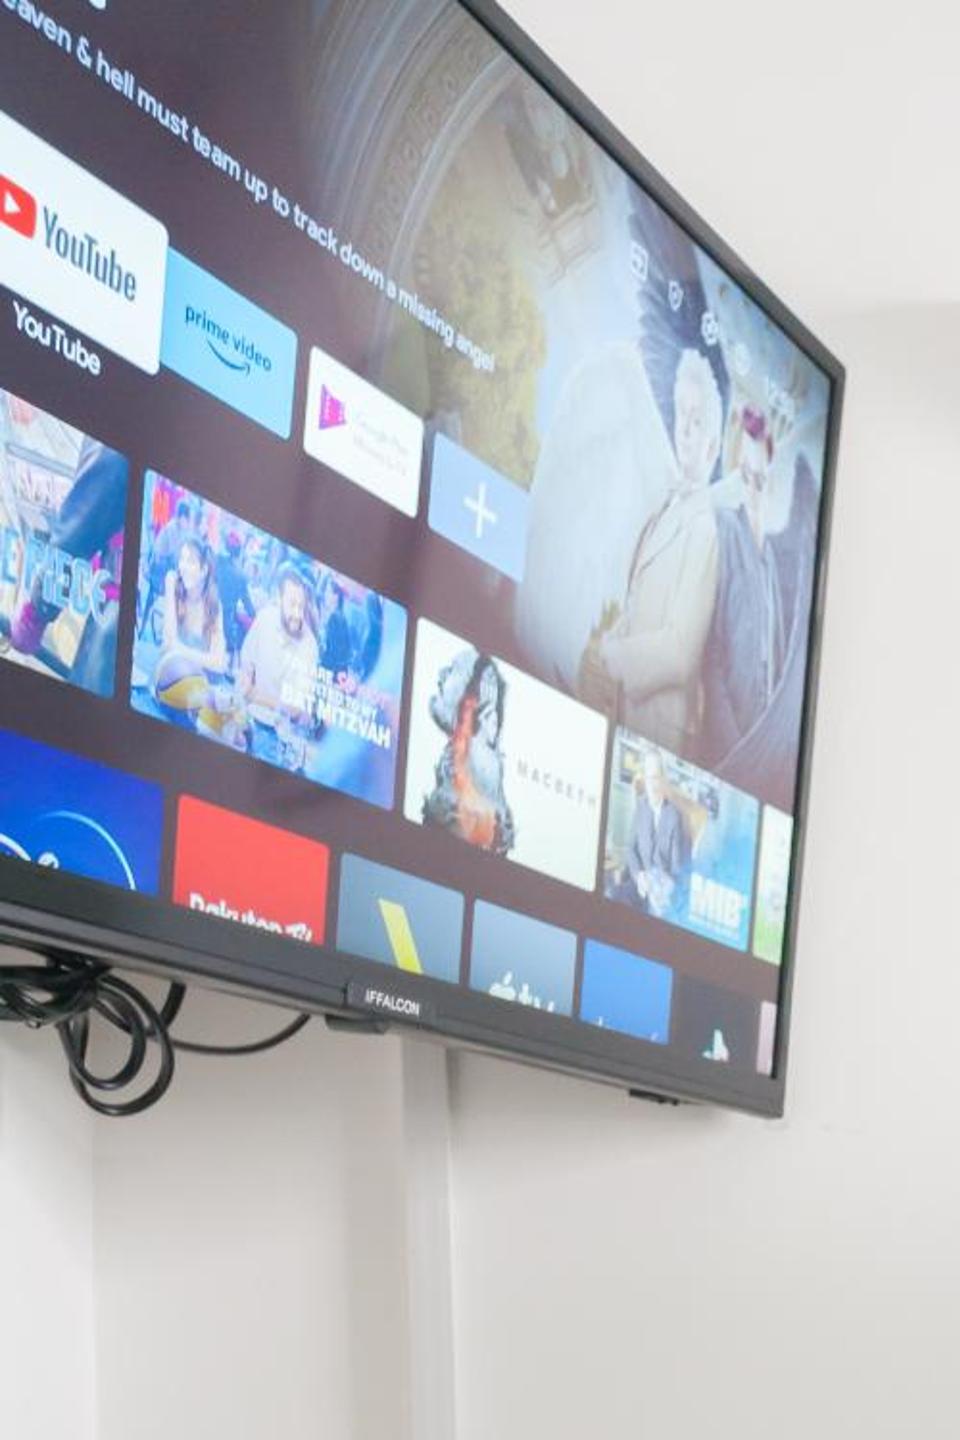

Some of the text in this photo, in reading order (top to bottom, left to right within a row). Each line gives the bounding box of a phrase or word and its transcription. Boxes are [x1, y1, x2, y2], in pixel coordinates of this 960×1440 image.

[76, 35, 92, 69] &
[96, 50, 135, 100] hell
[137, 86, 189, 143] must
[191, 126, 241, 181] team
[244, 168, 268, 203] up
[272, 187, 290, 218] to
[293, 203, 338, 256] track
[339, 243, 385, 291] down
[386, 279, 397, 299] a
[398, 288, 455, 348] missing
[455, 333, 495, 373] angel
[43, 206, 137, 302] YouTube
[12, 299, 102, 376] YouTube
[184, 305, 272, 372] prime video
[365, 988, 420, 1017] IFFALCON
